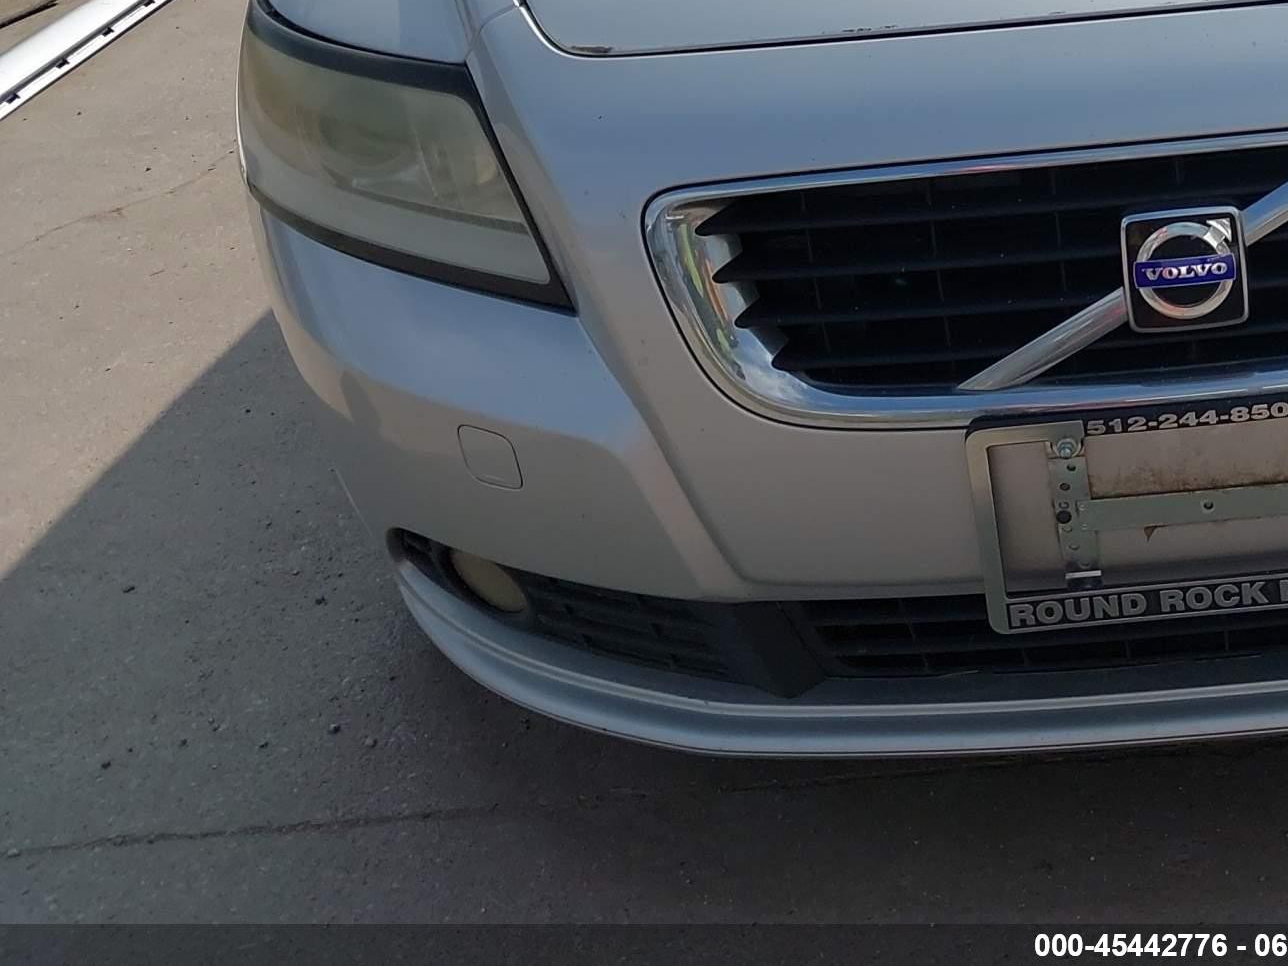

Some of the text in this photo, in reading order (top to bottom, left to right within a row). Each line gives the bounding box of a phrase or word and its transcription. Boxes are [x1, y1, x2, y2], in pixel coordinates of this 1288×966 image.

[1141, 262, 1228, 281] VOLVO
[1009, 593, 1147, 627] ROUND
[1160, 582, 1269, 613] ROCK
